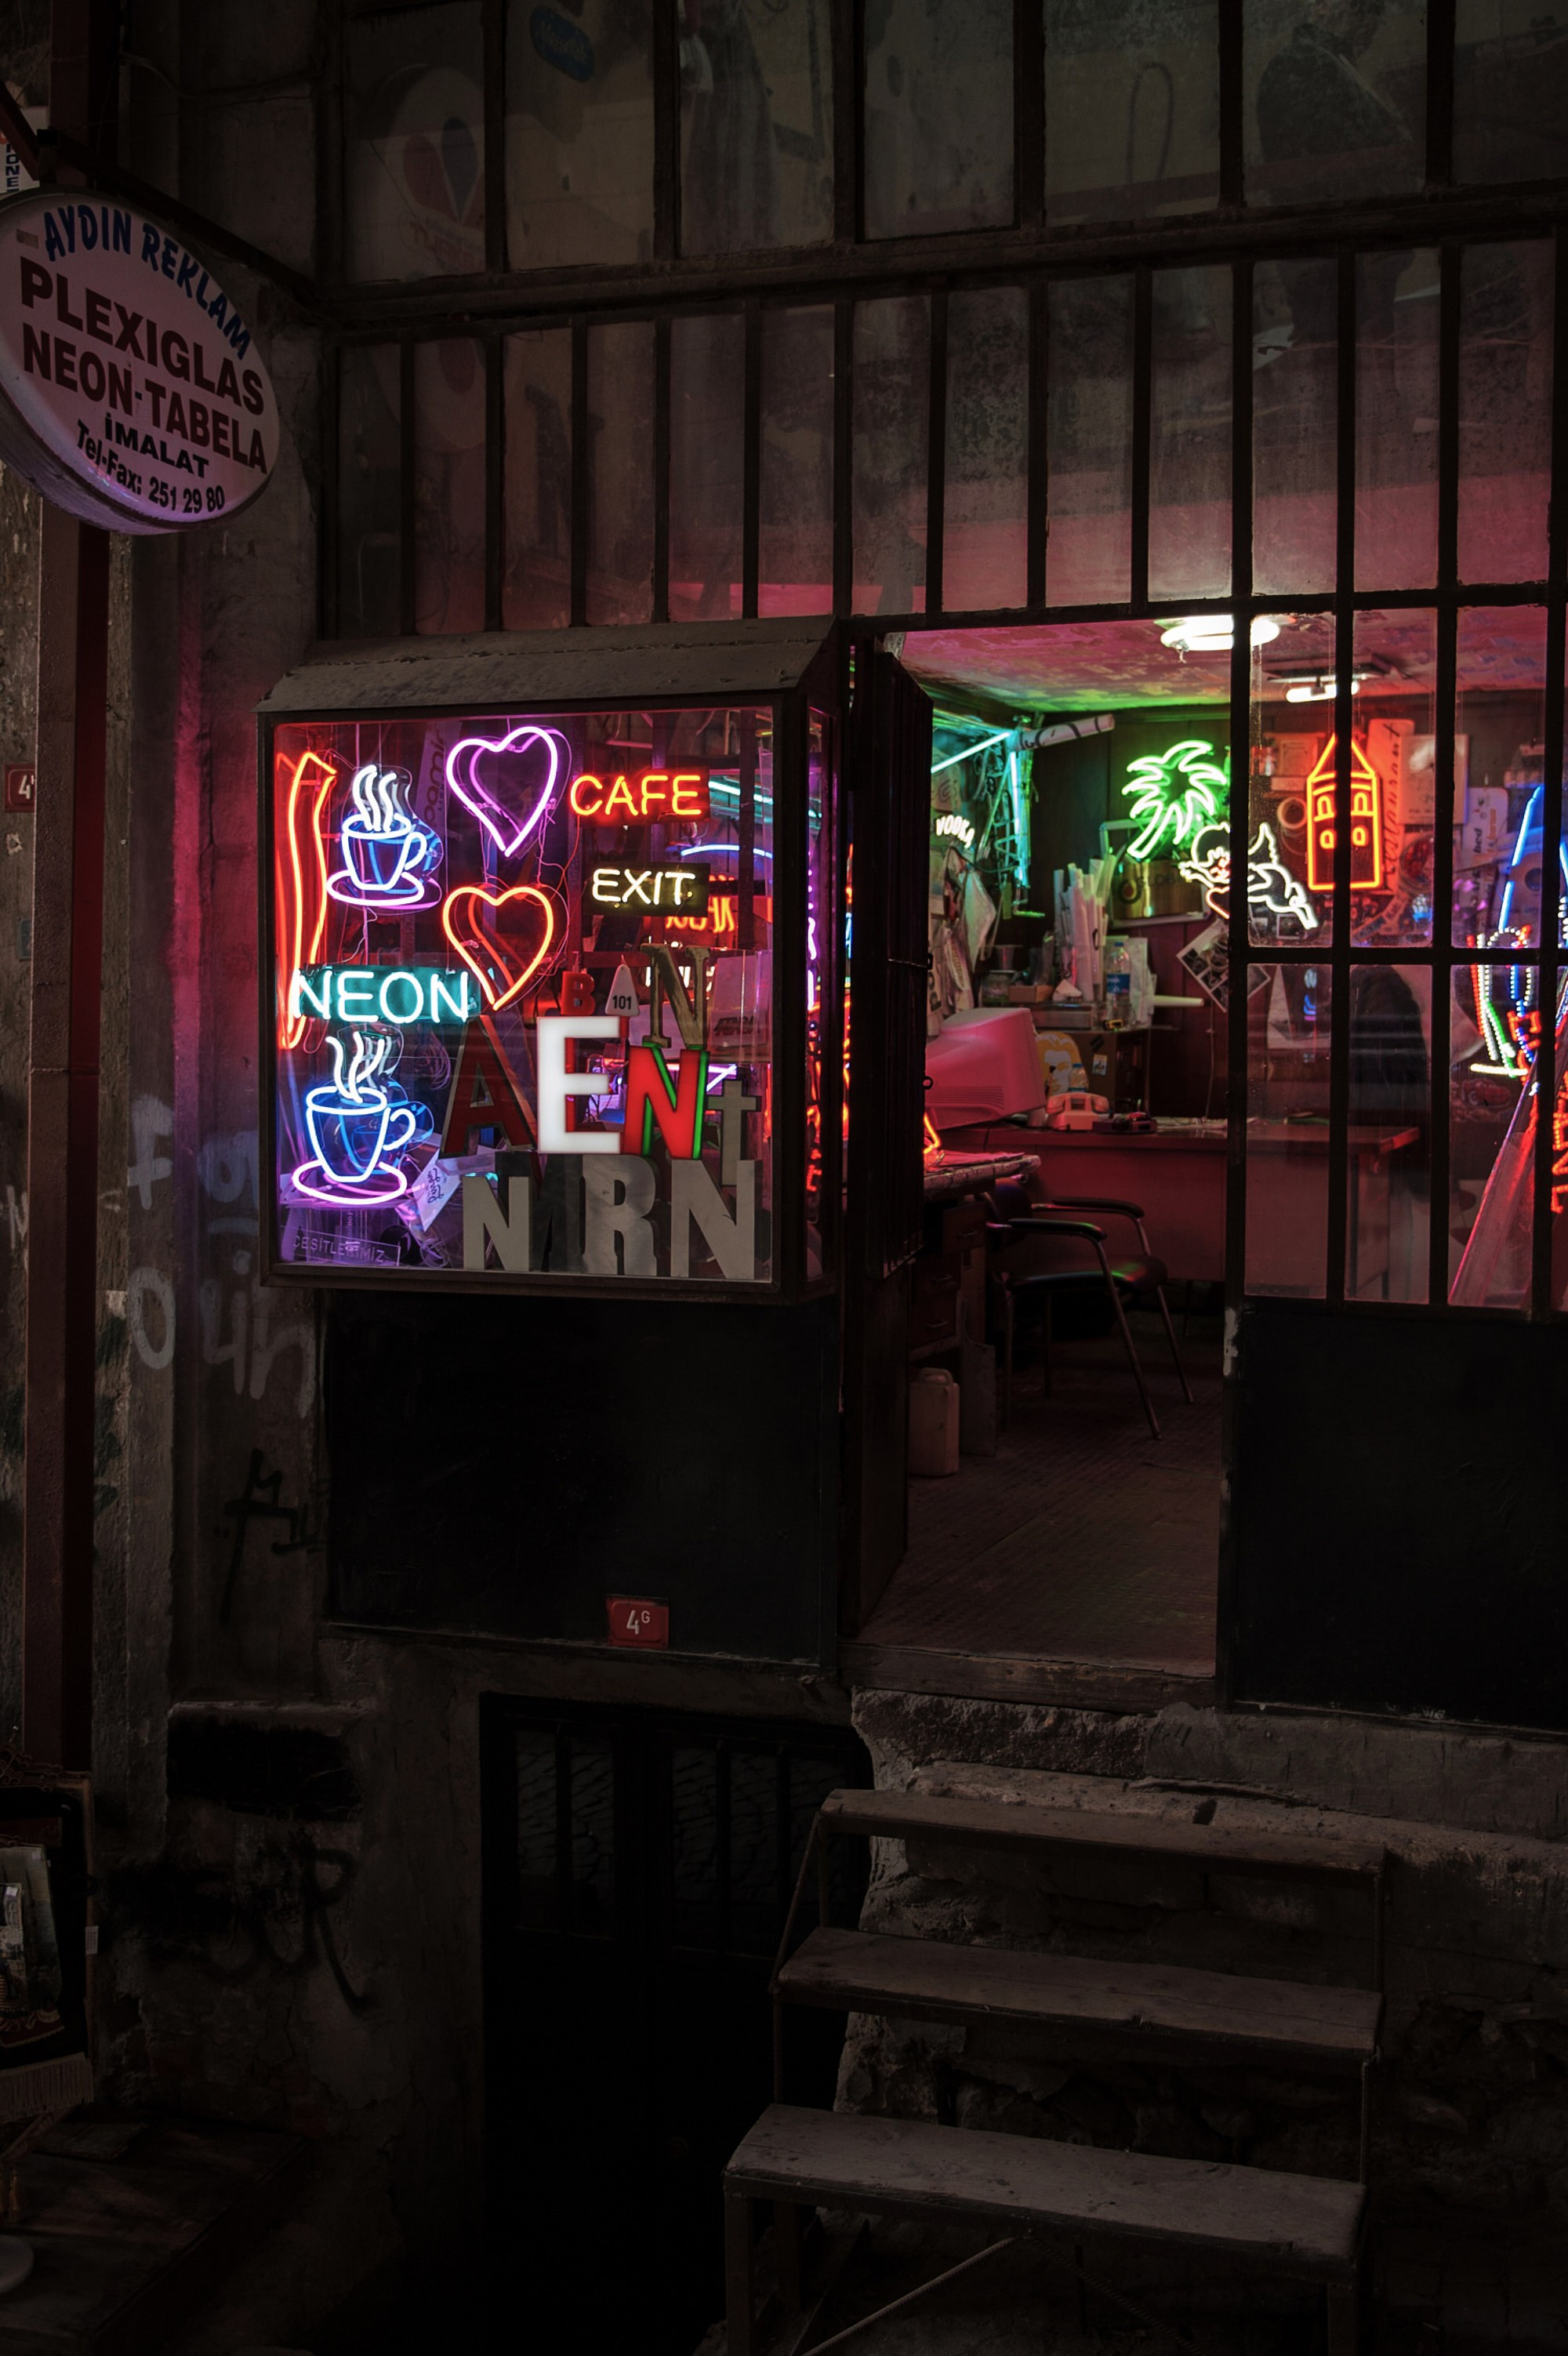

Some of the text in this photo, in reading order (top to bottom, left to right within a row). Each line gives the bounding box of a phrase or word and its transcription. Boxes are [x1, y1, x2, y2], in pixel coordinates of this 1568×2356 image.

[45, 205, 252, 360] AYDIN REKLAM
[20, 256, 264, 416] PLEXIGLAS
[22, 322, 267, 474] NEON-TABELA
[104, 412, 209, 478] İMALAT
[148, 476, 177, 511] 251
[183, 488, 203, 514] 29
[205, 485, 226, 513] 80
[569, 774, 703, 817] CAFE
[591, 868, 696, 906] EXIT
[294, 970, 470, 1024] NEON
[612, 995, 633, 1011] 101
